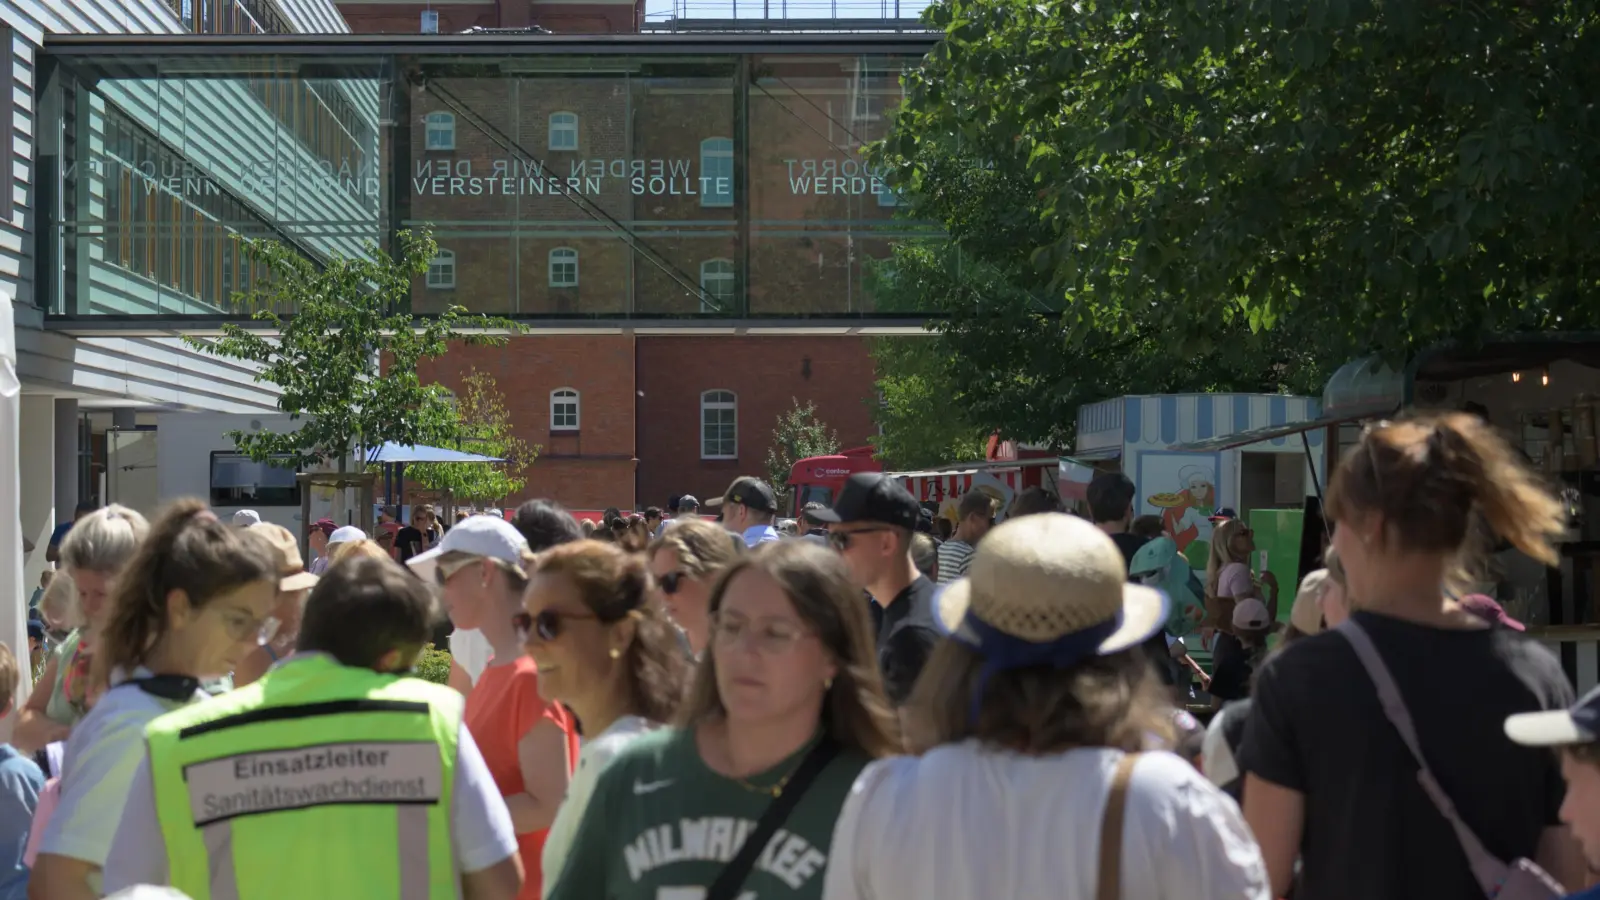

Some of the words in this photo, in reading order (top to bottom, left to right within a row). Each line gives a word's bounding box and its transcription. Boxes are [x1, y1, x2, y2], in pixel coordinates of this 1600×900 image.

[143, 178, 220, 195] WENN
[312, 177, 379, 195] WIND
[413, 177, 600, 195] VERSTEINERN
[631, 177, 730, 195] SOLLTE
[233, 749, 389, 779] Einsatzleiter
[204, 777, 426, 817] Sanitätswachdienst
